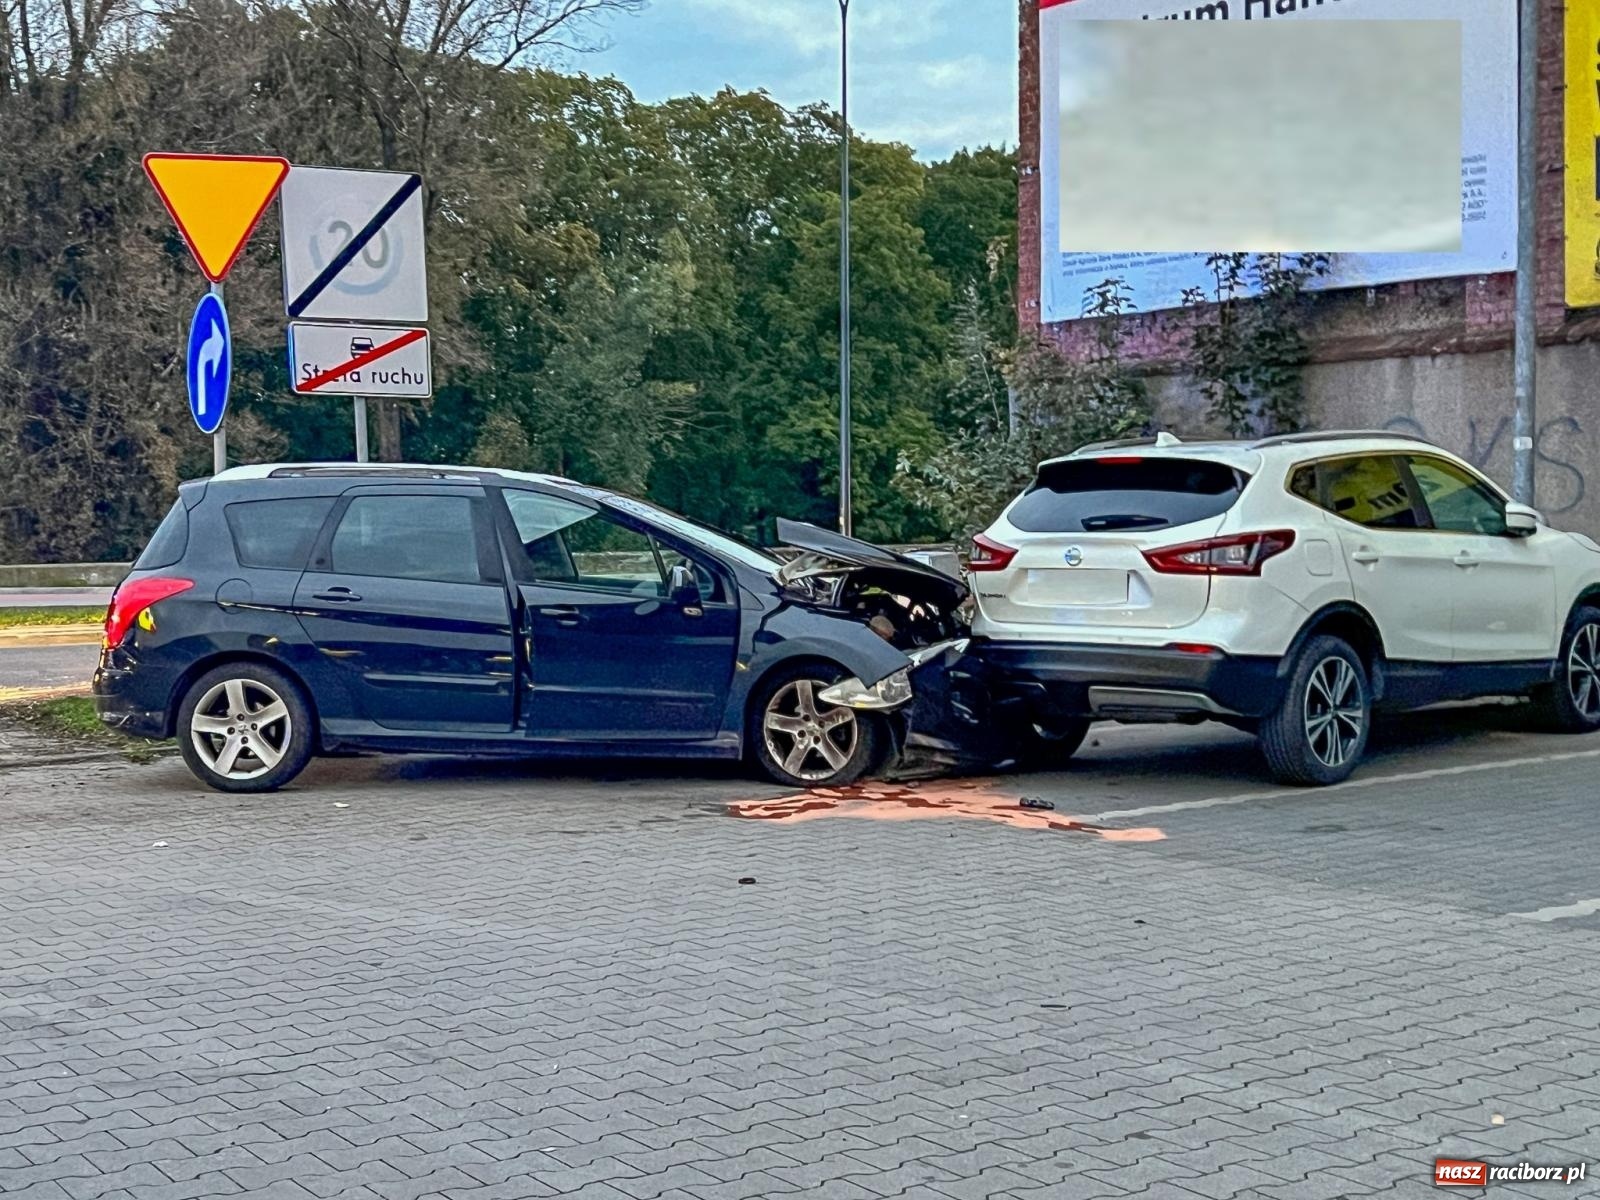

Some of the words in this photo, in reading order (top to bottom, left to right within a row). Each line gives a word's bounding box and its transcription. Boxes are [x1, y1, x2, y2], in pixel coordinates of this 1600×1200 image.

[328, 220, 389, 269] 20
[301, 362, 361, 383] Sta
[371, 367, 424, 385] ruchu
